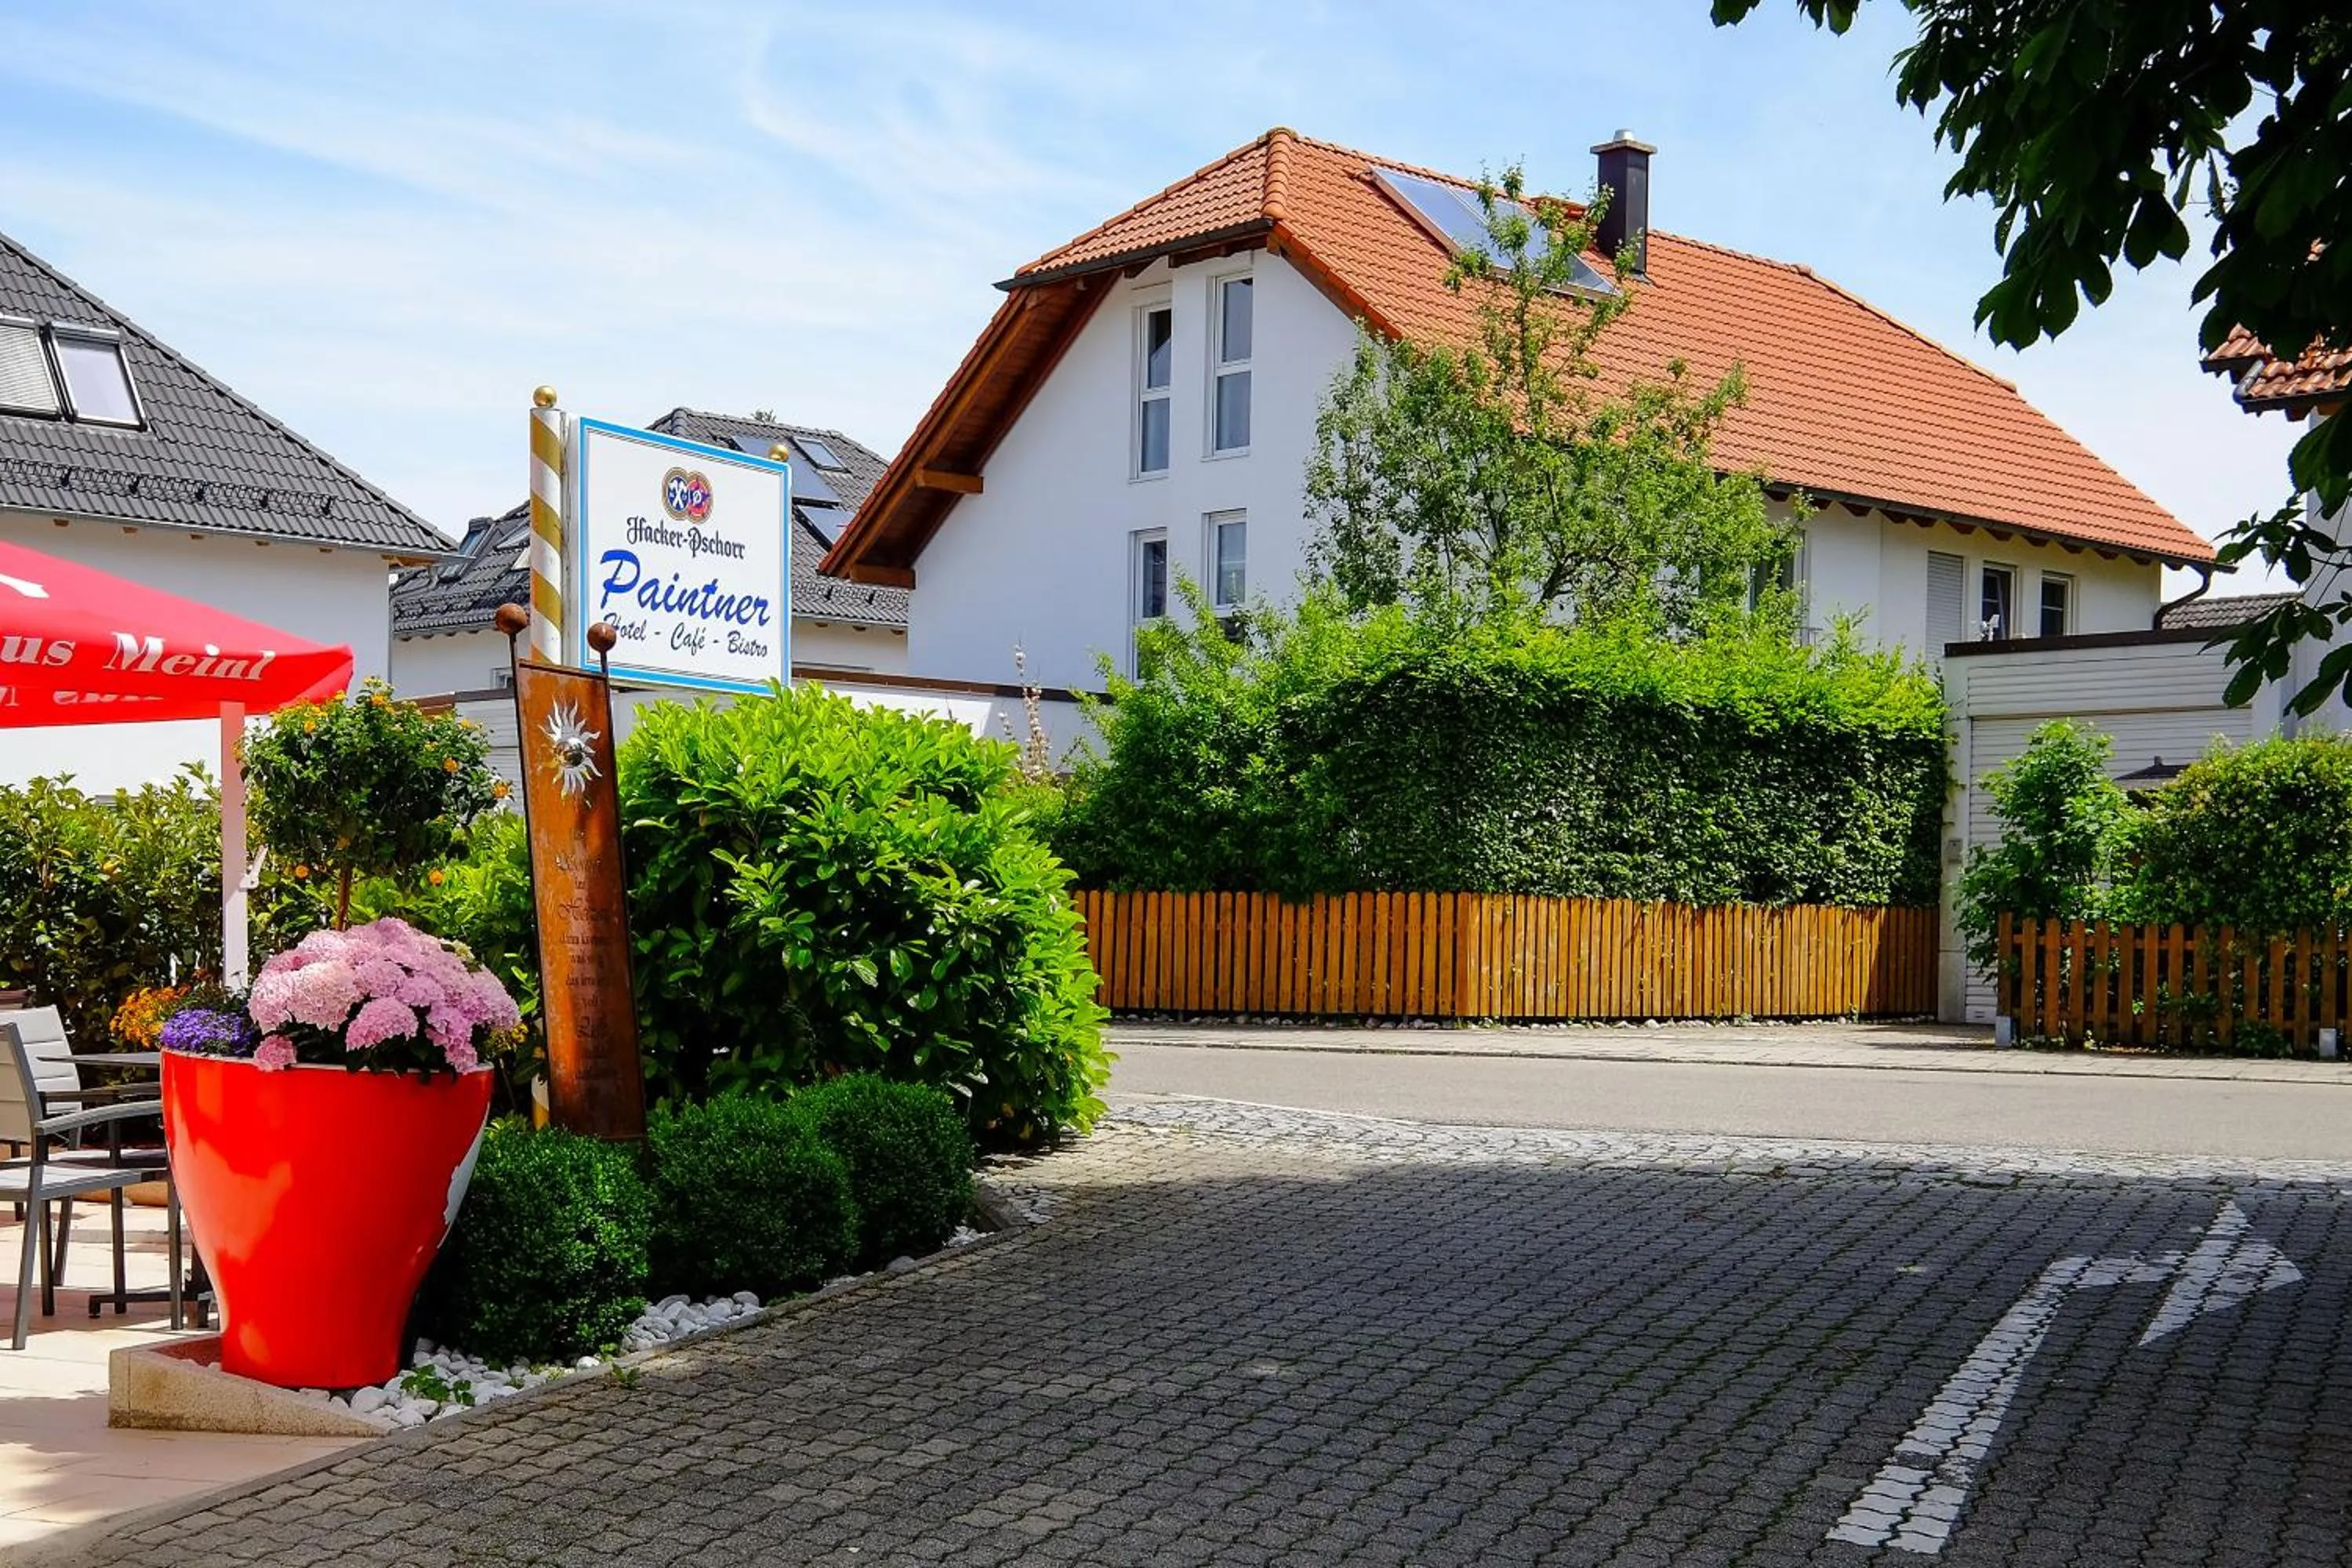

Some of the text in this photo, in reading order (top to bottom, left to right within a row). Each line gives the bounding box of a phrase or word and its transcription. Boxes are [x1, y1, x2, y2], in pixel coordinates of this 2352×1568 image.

[626, 516, 746, 560] Hacker-Pschorr
[600, 549, 771, 627] Paintner
[102, 631, 277, 681] Meinl
[670, 622, 706, 656] Café
[728, 630, 768, 658] Bistro
